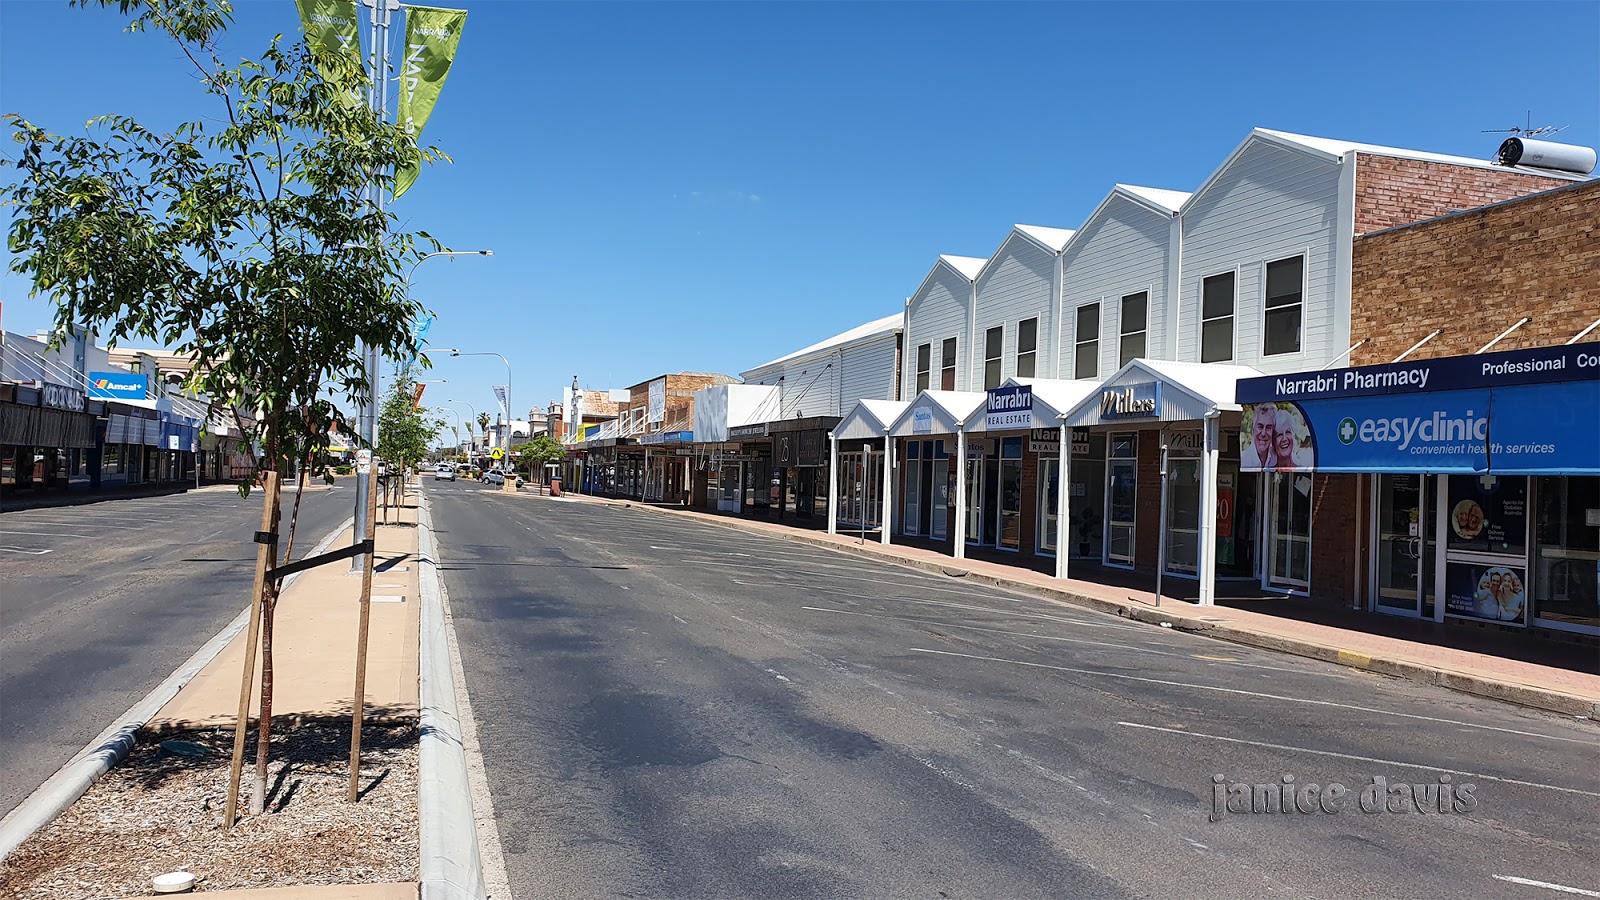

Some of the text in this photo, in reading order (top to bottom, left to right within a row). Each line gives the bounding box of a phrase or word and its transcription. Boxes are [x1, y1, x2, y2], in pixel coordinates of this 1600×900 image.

[412, 27, 451, 37] NARRABRI
[1482, 355, 1566, 376] Professional
[1275, 367, 1430, 396] Narrabri Pharmacy
[988, 388, 1031, 410] Narrabri
[1100, 389, 1155, 415] Millers
[988, 414, 1031, 425] REAL ESTATE
[1359, 409, 1488, 450] easyclinic
[1032, 428, 1088, 442] Narbri
[1170, 432, 1204, 448] Mill
[1410, 443, 1466, 455] convenient
[1505, 443, 1555, 454] services
[1217, 499, 1229, 520] 0
